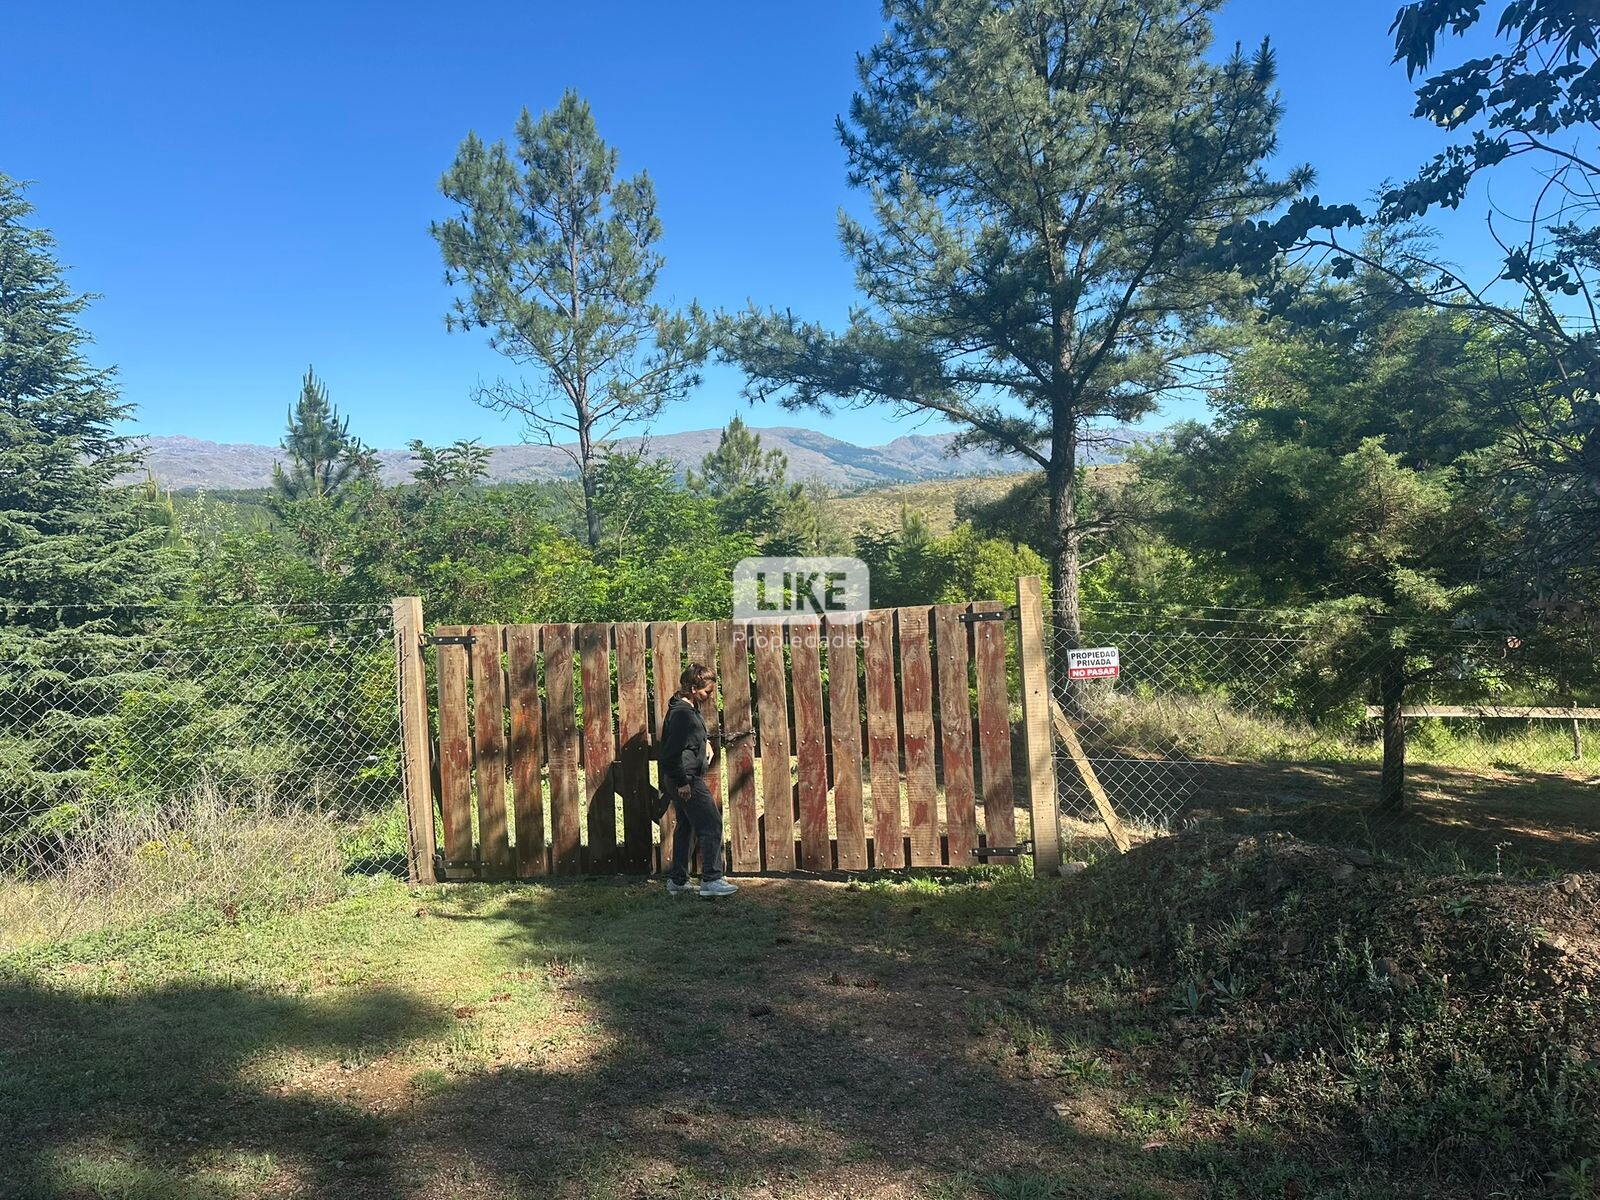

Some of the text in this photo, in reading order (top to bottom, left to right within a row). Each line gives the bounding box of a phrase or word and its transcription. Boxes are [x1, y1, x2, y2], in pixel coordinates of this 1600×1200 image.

[1071, 651, 1115, 659] PROPIEDAD
[1077, 658, 1111, 667] PRIVADA
[1072, 668, 1115, 677] NO PASAR
